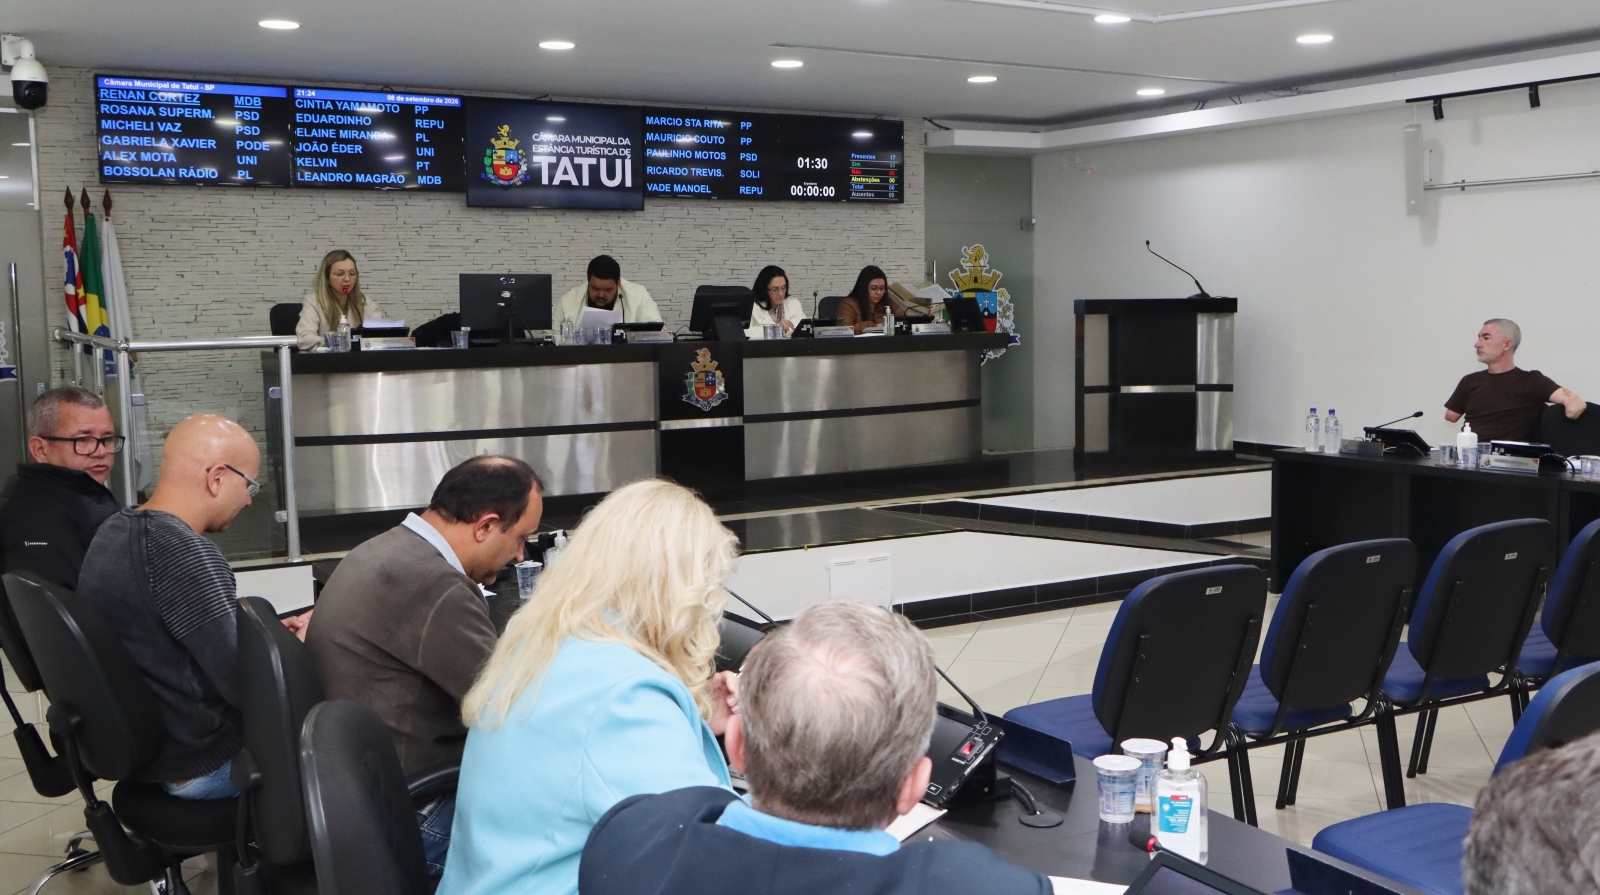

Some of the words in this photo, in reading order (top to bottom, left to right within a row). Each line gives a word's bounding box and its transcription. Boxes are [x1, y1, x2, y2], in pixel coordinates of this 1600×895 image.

[134, 81, 169, 89] Municipal
[100, 89, 145, 100] RENAN
[150, 92, 200, 103] CORTEZ
[234, 96, 261, 106] MDB
[101, 105, 155, 116] ROSANA
[159, 107, 215, 118] SUPERM.
[296, 99, 333, 110] CINTIA
[336, 101, 400, 113] YAMAMOTO
[415, 106, 428, 114] PP
[235, 111, 259, 120] PSD
[296, 114, 371, 125] EDUARDINHO
[101, 120, 154, 131] MICHELI
[158, 122, 181, 132] VAZ
[415, 119, 444, 129] REPU
[646, 116, 682, 126] MARCIO
[685, 118, 701, 127] STA
[704, 120, 723, 128] RITA
[236, 126, 260, 135] PSD
[297, 128, 336, 138] ELAINE
[340, 130, 389, 140] MIRANDA
[102, 136, 168, 147] GABRIELA
[172, 138, 216, 148] XAVIER
[416, 133, 429, 142] PL
[533, 132, 571, 142] CÂMARA
[572, 135, 617, 145] MUNICIPAL
[618, 137, 630, 145] DA
[646, 133, 691, 142] MAURICIO
[694, 135, 725, 144] COUTO
[236, 141, 269, 150] PODE
[296, 141, 328, 152] JOÃO
[332, 142, 362, 153] ÉDER
[533, 143, 574, 154] ESTÂNCIA
[576, 145, 618, 155] TURÍSTICA
[103, 151, 137, 161] ALEX
[141, 152, 176, 162] MOTA
[416, 148, 434, 156] UNI
[647, 149, 692, 158] PAULINHO
[695, 150, 726, 160] MOTOS
[237, 156, 257, 165] UNI
[297, 158, 337, 167] KELVIN
[417, 162, 430, 170] PT
[798, 157, 828, 169] 01:30
[104, 166, 175, 177] BOSSOLAN
[179, 166, 218, 178] RÁDIO
[238, 170, 252, 179] PL
[533, 154, 632, 187] TATUÍ
[647, 166, 688, 176] RICARDO
[691, 168, 724, 177] TREVIS.
[297, 172, 352, 182] LEANDRO
[356, 173, 405, 184] MAGRÃO
[418, 176, 441, 184] MDB
[647, 183, 670, 192] VADE
[674, 184, 711, 193] MANOEL
[791, 185, 835, 196] 00:00:00
